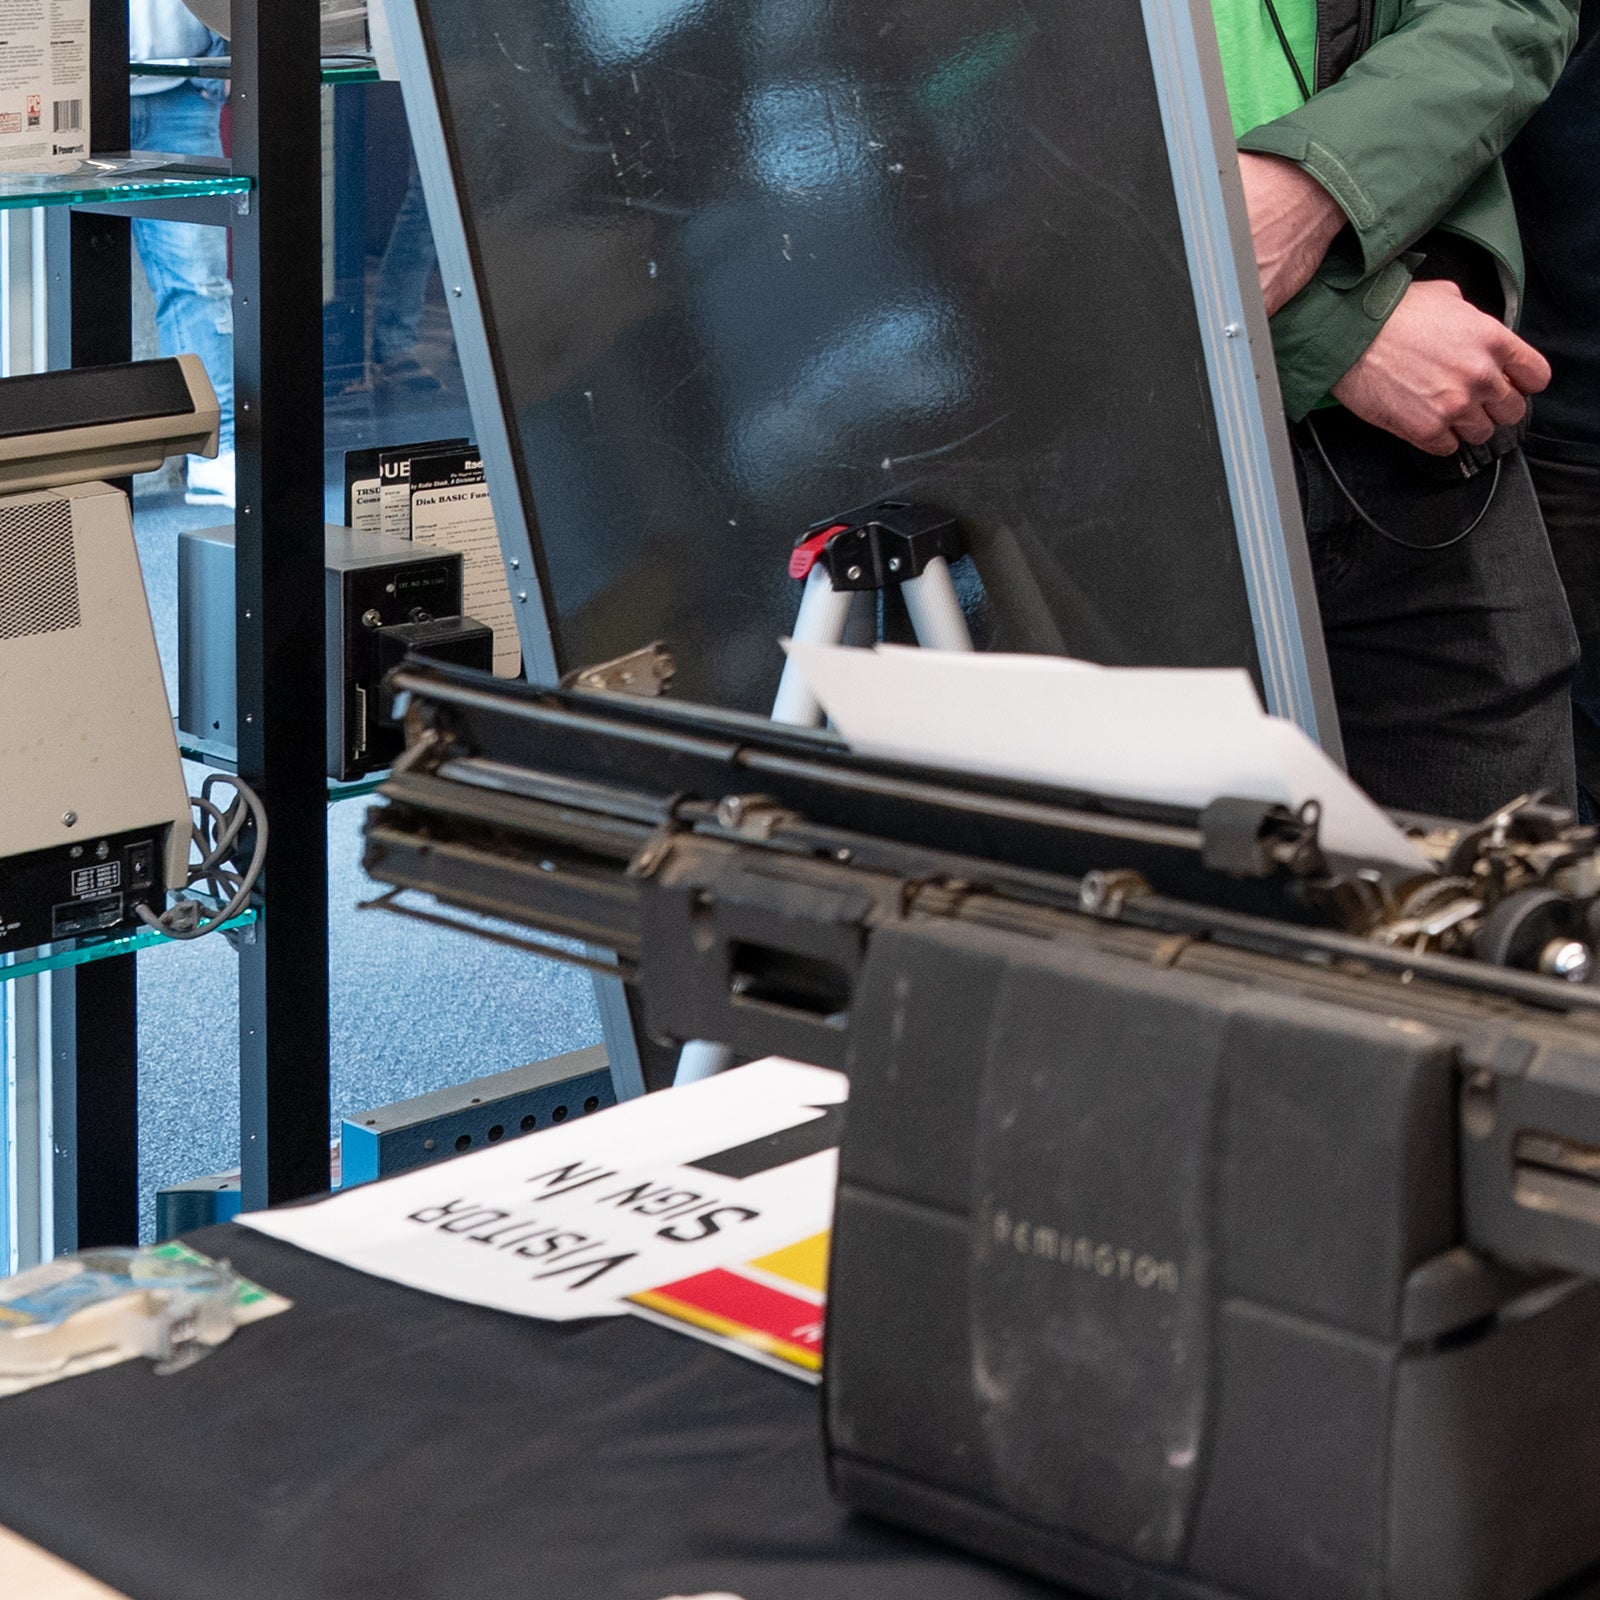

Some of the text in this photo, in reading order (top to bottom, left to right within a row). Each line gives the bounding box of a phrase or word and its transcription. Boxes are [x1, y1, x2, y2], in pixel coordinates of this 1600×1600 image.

[416, 498, 436, 506] Disk
[439, 492, 468, 503] BASIC
[526, 1161, 618, 1202] IN
[407, 1197, 640, 1291] VISITOR
